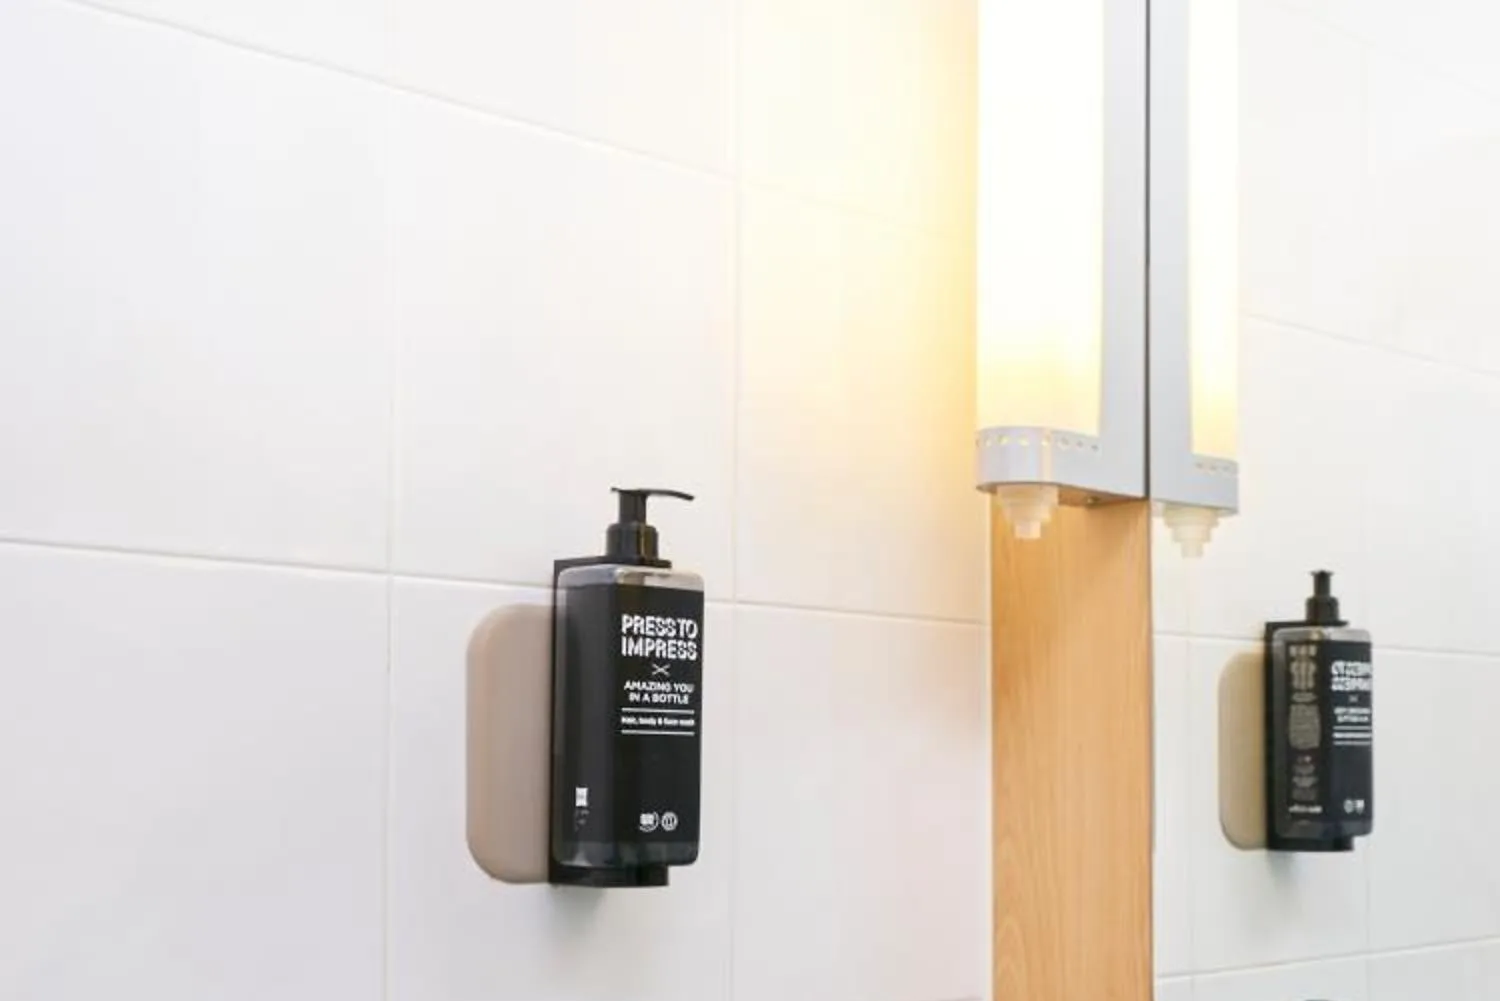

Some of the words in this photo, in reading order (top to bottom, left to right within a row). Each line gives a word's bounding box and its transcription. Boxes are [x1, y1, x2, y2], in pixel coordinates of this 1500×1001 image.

[621, 614, 677, 637] PRESS
[677, 618, 698, 639] TO
[621, 636, 698, 661] IMPRESS
[624, 681, 672, 692] AMAZING
[673, 682, 695, 693] YOU
[629, 692, 641, 702] IN
[642, 693, 651, 703] A
[651, 693, 689, 704] BOTTLE
